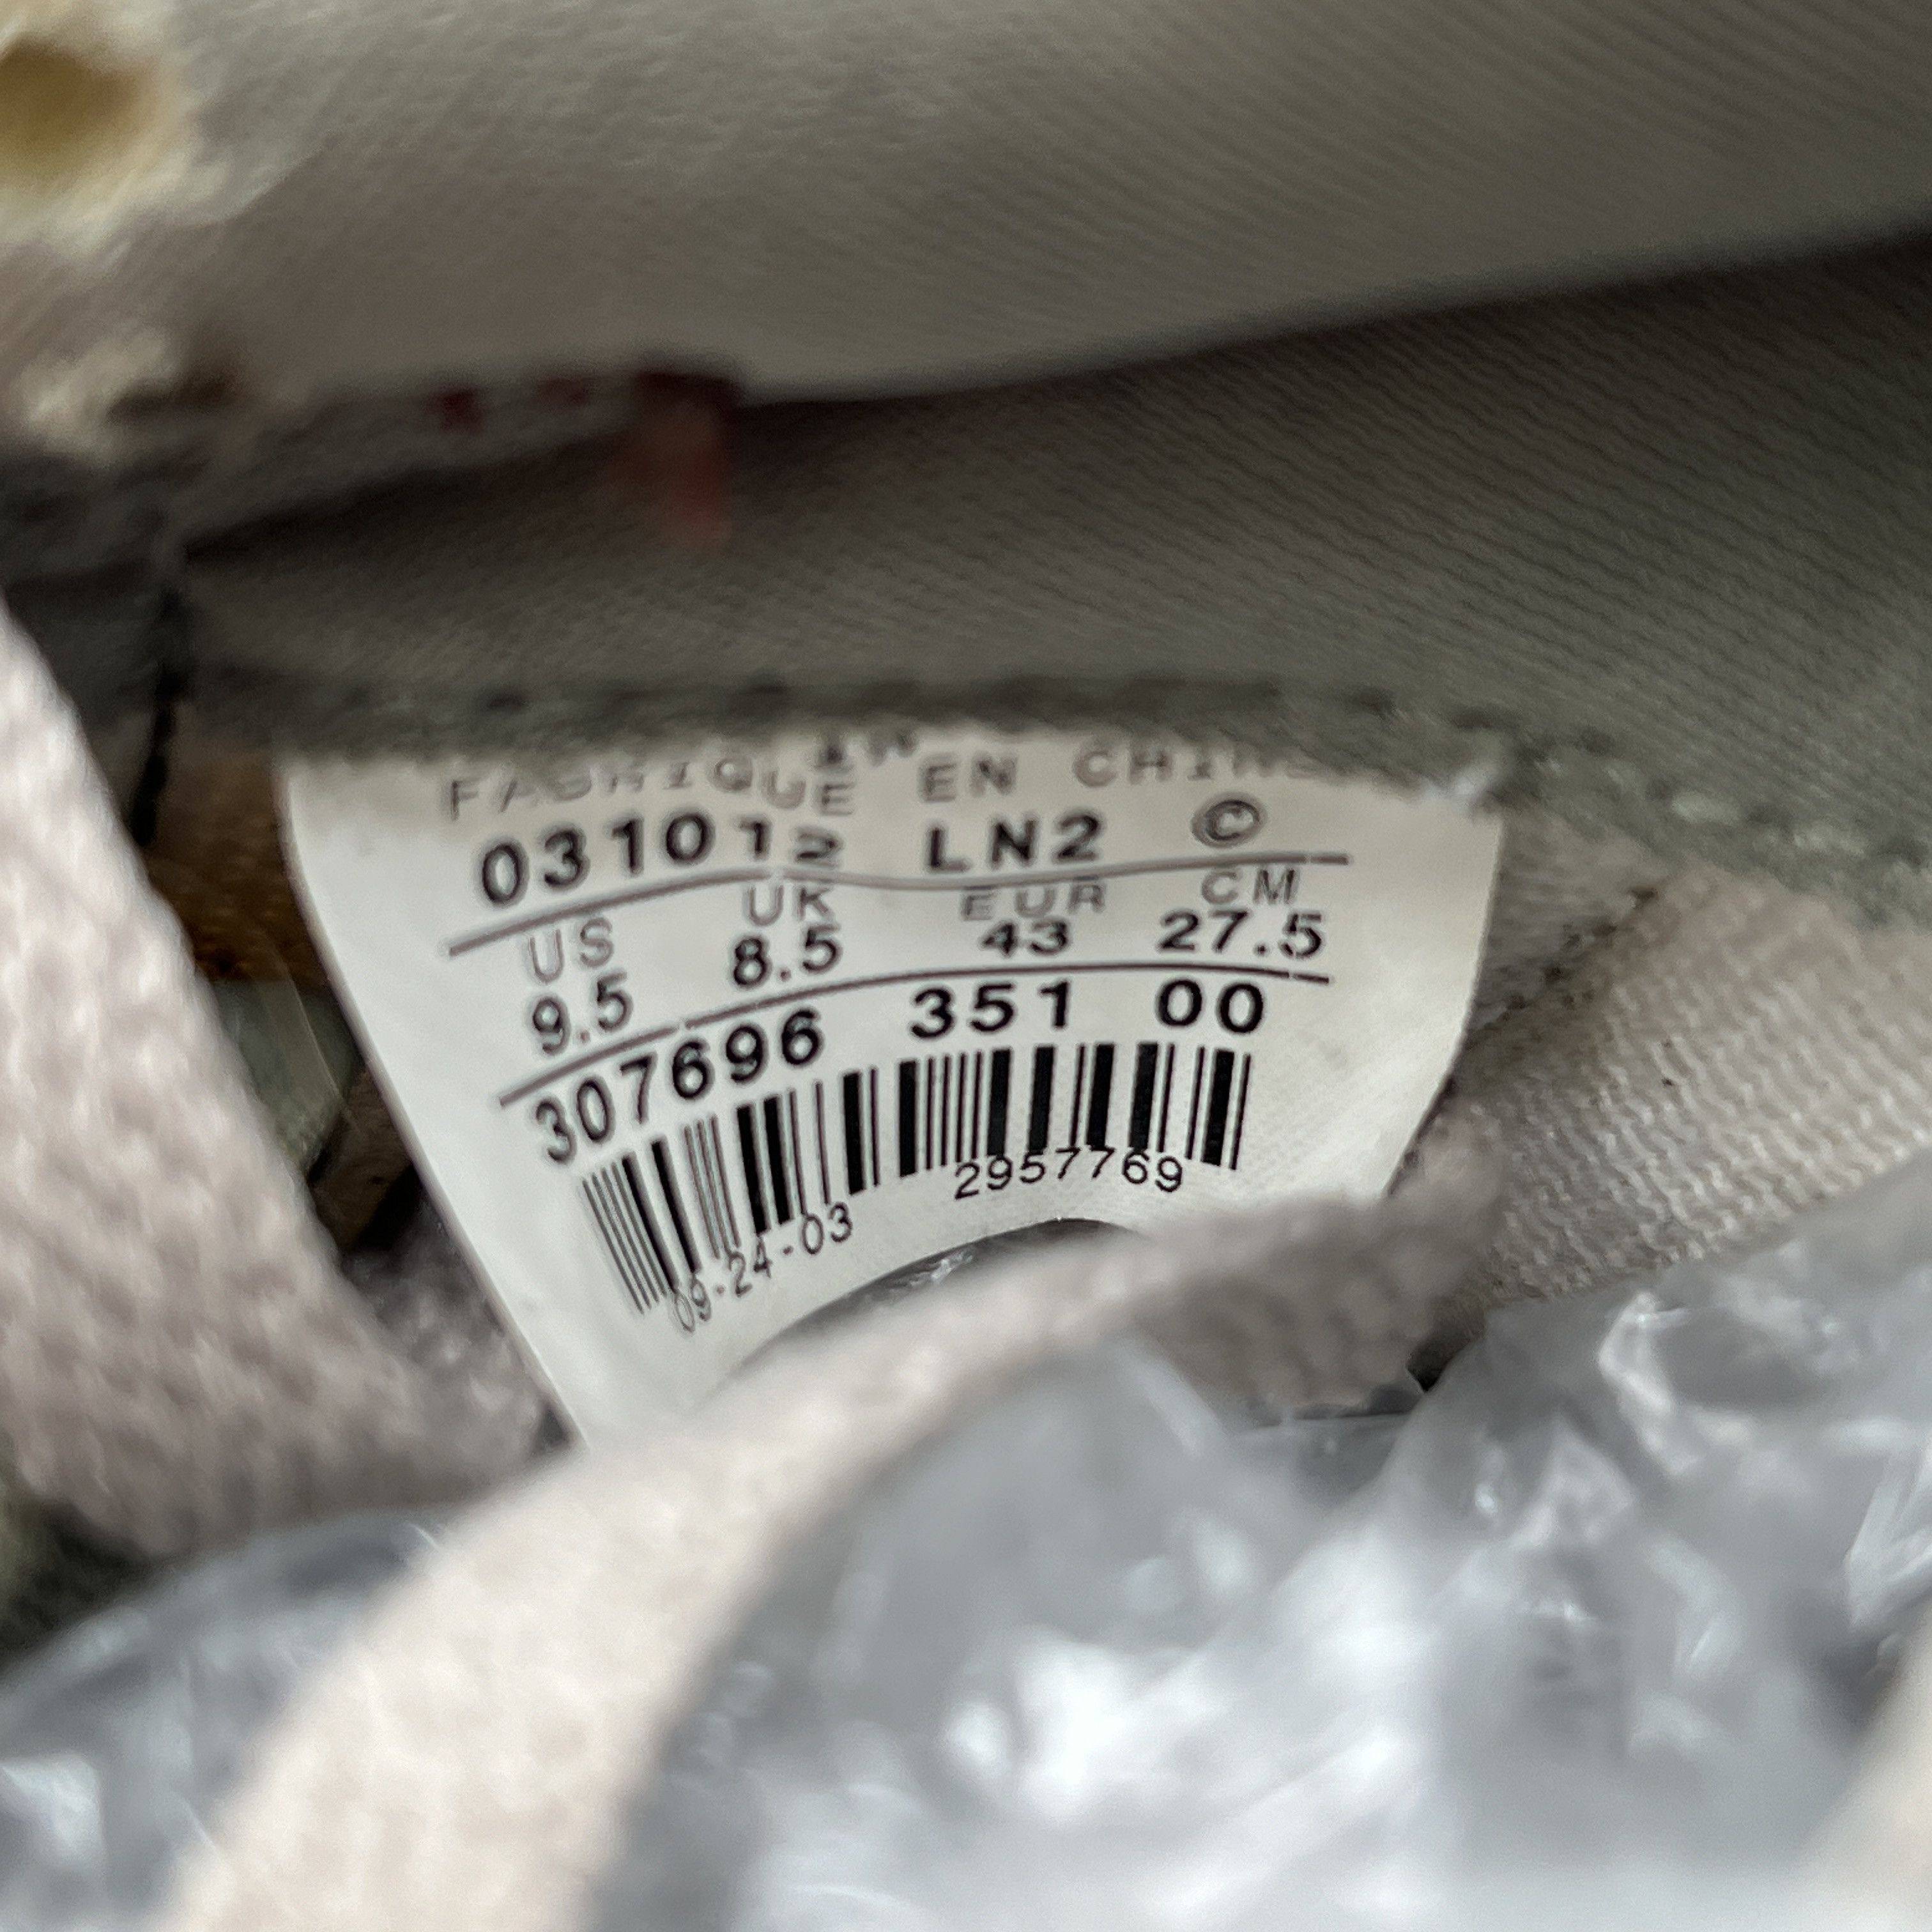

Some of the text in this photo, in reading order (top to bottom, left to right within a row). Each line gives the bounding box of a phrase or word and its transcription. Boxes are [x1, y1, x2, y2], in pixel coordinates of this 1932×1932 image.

[922, 755, 1017, 802] EN
[1073, 741, 1315, 788] CHI
[482, 813, 838, 904] 031012
[926, 814, 1101, 871] LN2
[527, 869, 1300, 983] US UK EUR CM
[532, 911, 1323, 1054] 9.5 8.5 43 27.5
[535, 979, 1265, 1164] 307696 351 00
[954, 1147, 1183, 1200] 2957769
